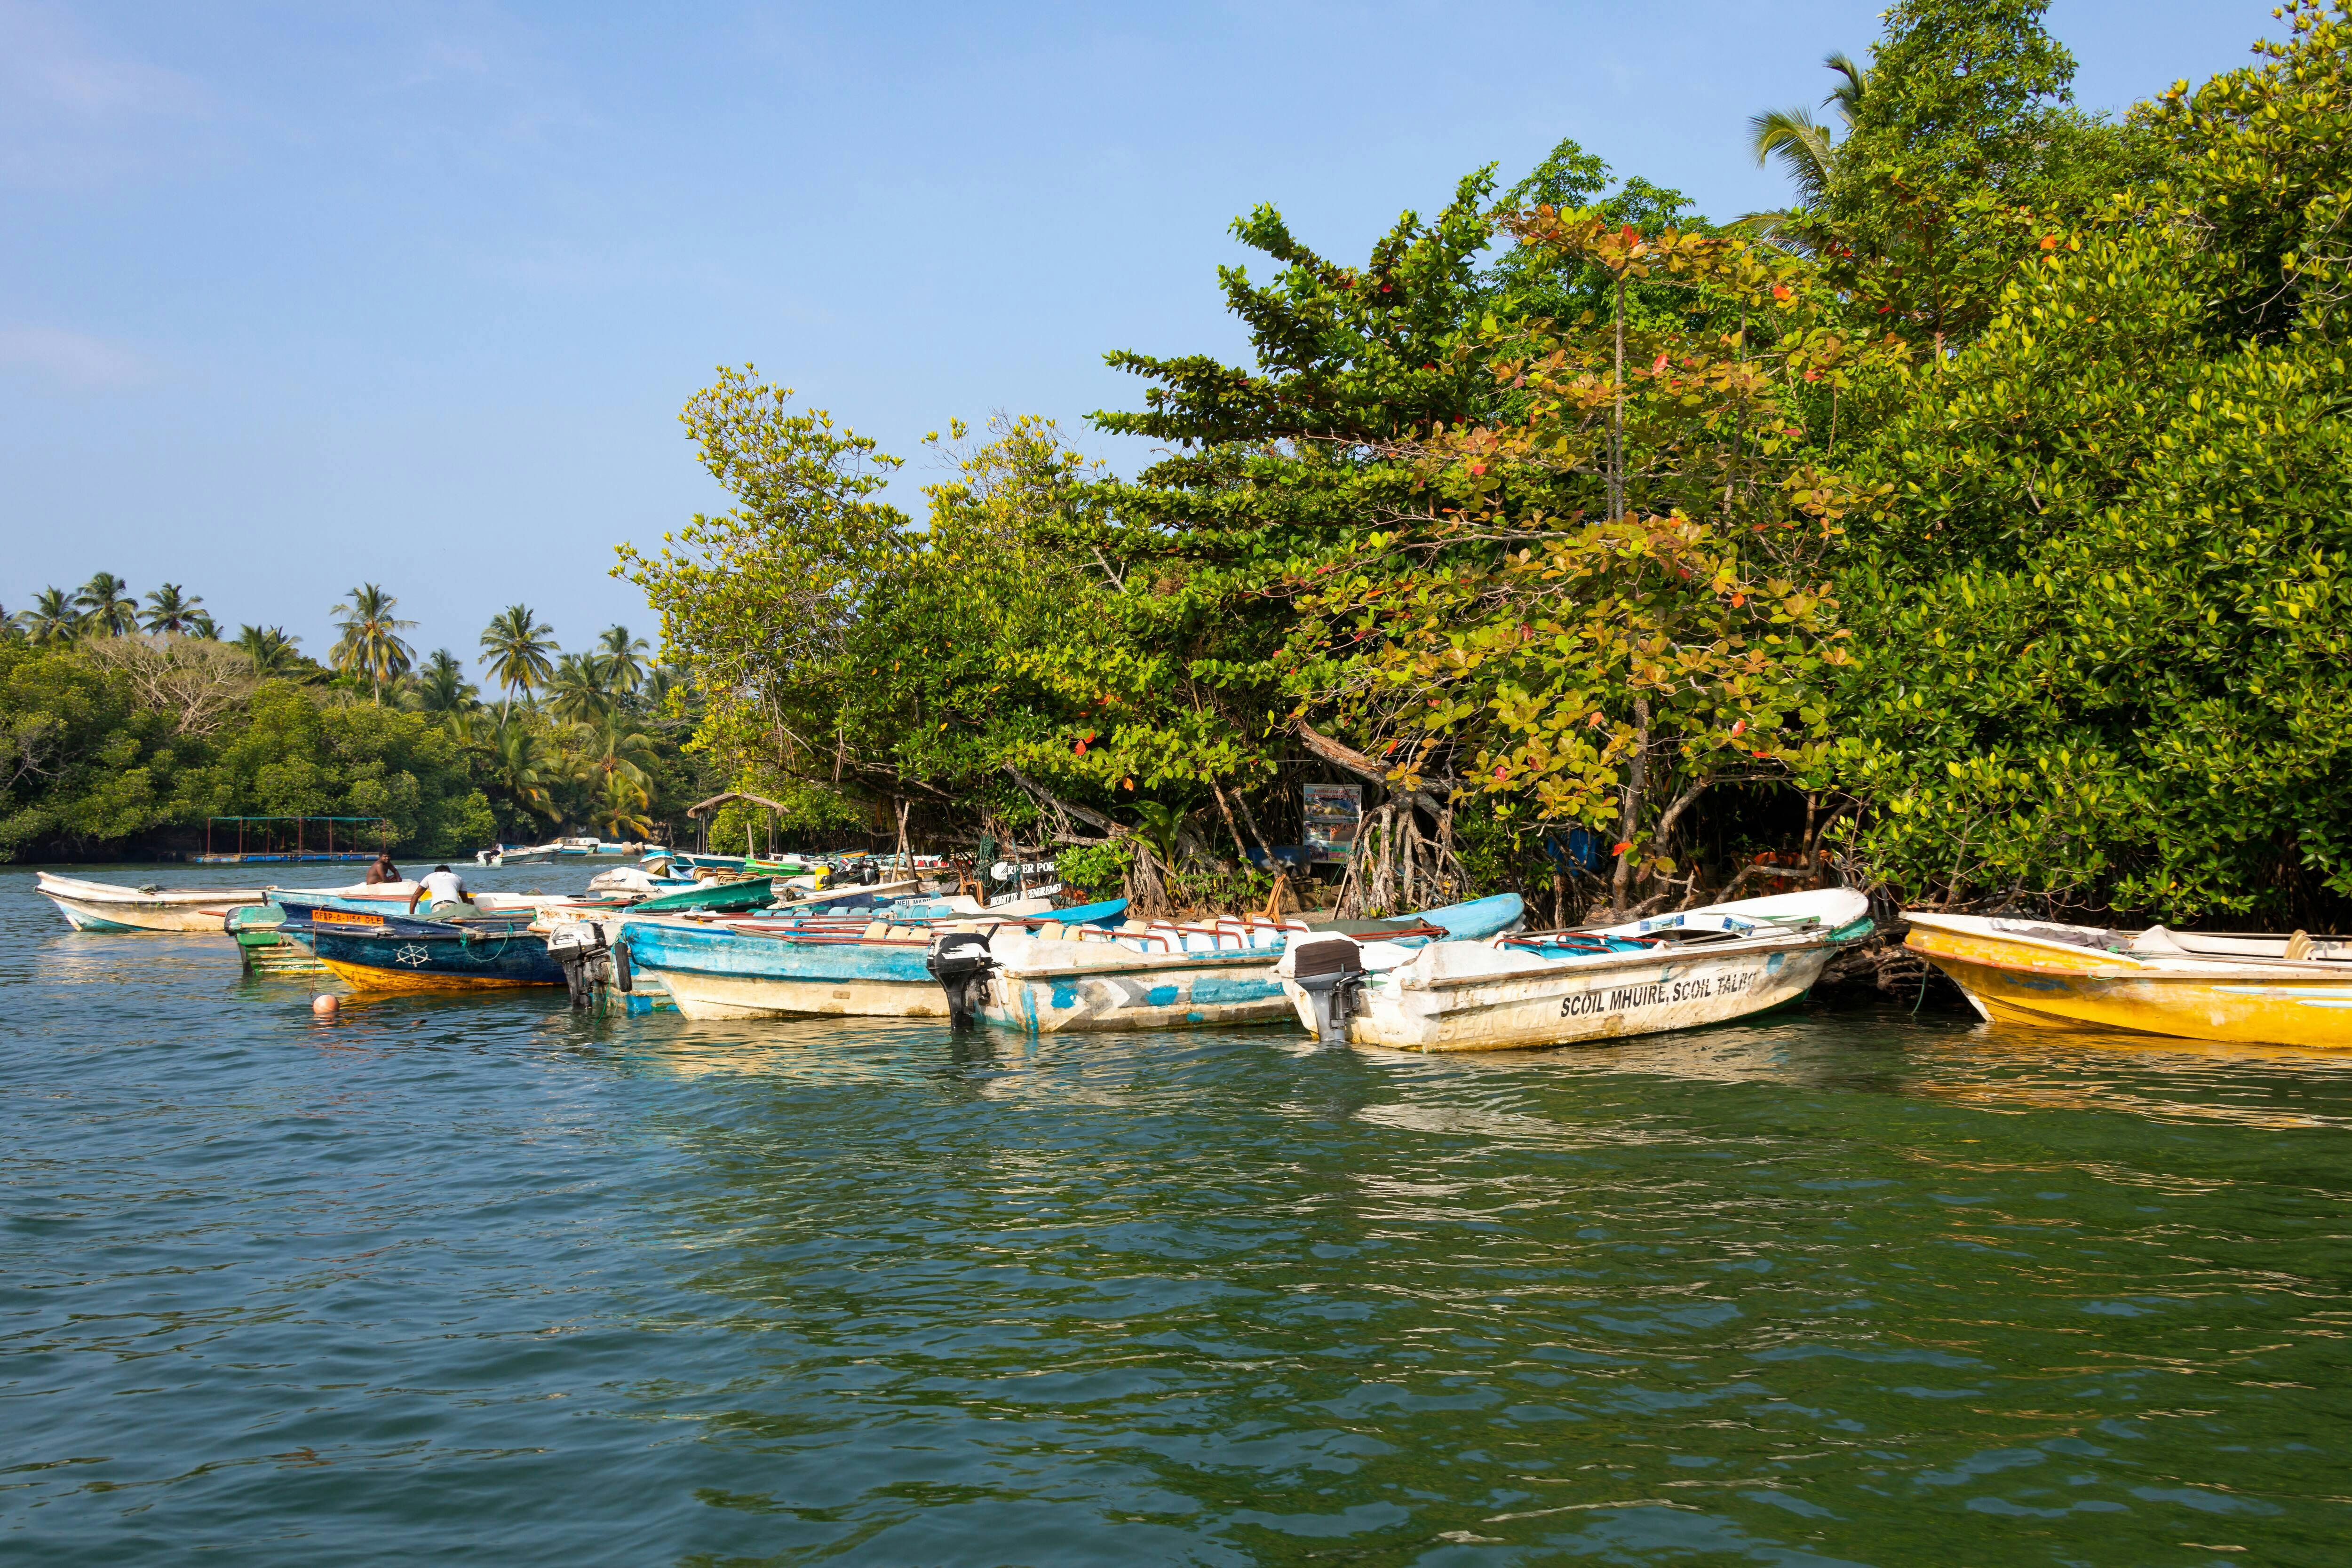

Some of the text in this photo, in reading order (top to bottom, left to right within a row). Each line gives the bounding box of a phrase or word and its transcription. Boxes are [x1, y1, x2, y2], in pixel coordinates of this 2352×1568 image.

[1036, 862, 1058, 872] POR
[1561, 992, 1604, 1017] SCOIL
[1610, 985, 1669, 1011] MHUIRE,
[1673, 979, 1711, 1002] SCOIL
